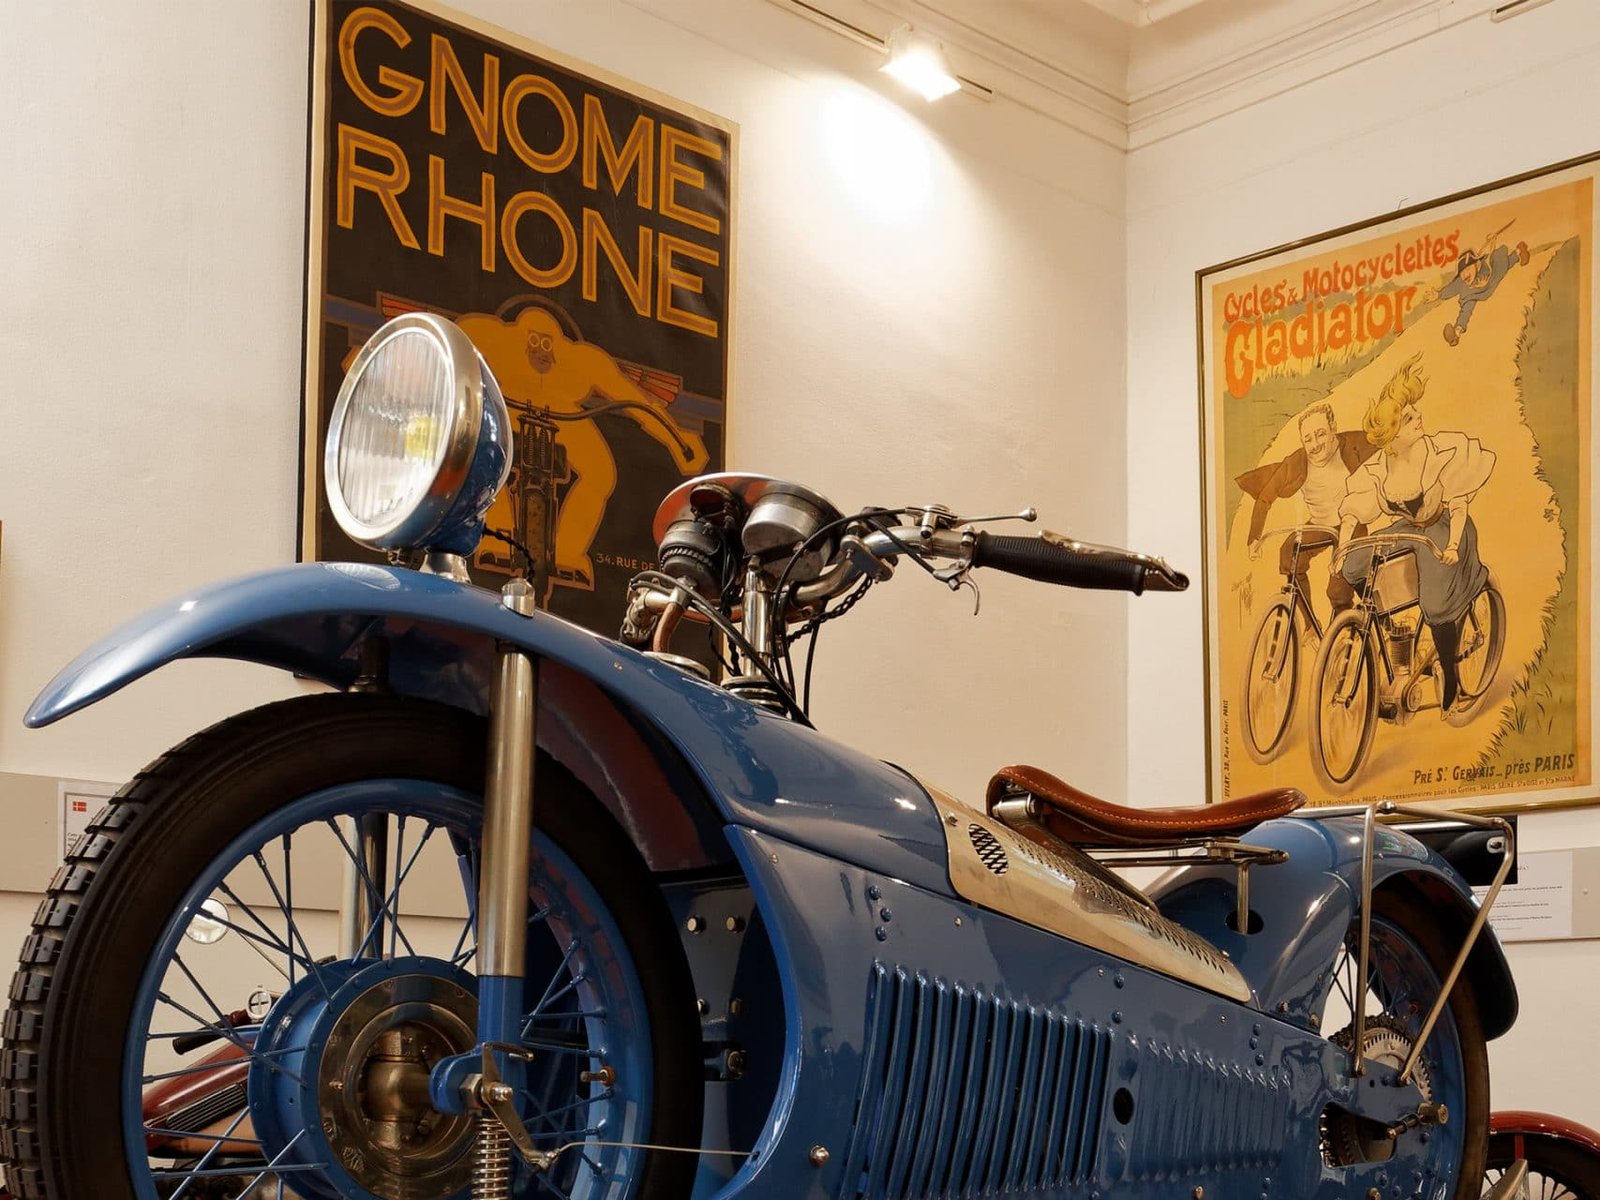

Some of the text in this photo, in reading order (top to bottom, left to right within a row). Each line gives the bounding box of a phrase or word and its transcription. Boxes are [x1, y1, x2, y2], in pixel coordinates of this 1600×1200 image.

[338, 6, 722, 236] GNOME
[336, 122, 720, 339] RHONE
[1223, 279, 1288, 324] Cycles
[1301, 229, 1461, 302] Motocyclettes
[1225, 285, 1418, 400] Gladiator
[1534, 753, 1576, 772] PARIS
